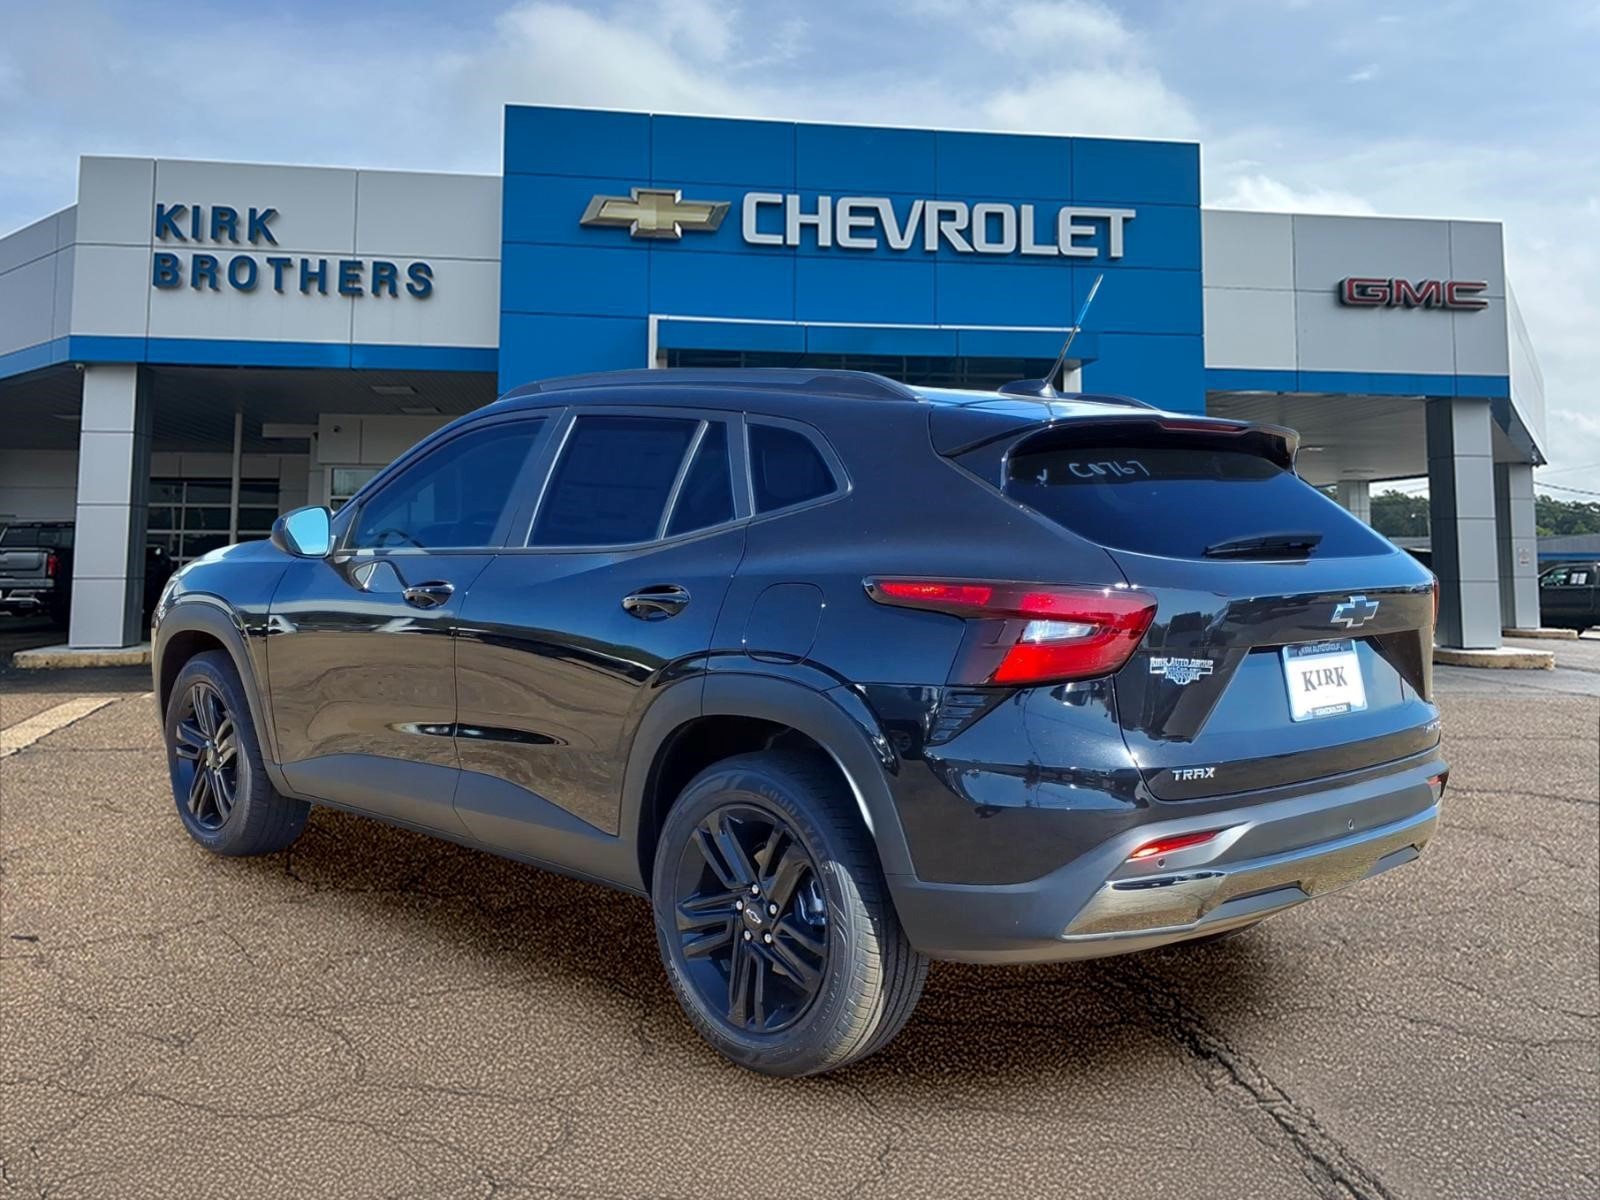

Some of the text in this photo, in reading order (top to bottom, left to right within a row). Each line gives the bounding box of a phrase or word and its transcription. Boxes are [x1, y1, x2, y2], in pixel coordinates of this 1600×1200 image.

[155, 203, 278, 246] KIRK
[742, 191, 1137, 258] CHEVROLET
[152, 252, 433, 299] BROTHERS
[1342, 277, 1489, 311] GMC
[1301, 666, 1348, 691] KIRK
[1172, 767, 1215, 781] TRAX
